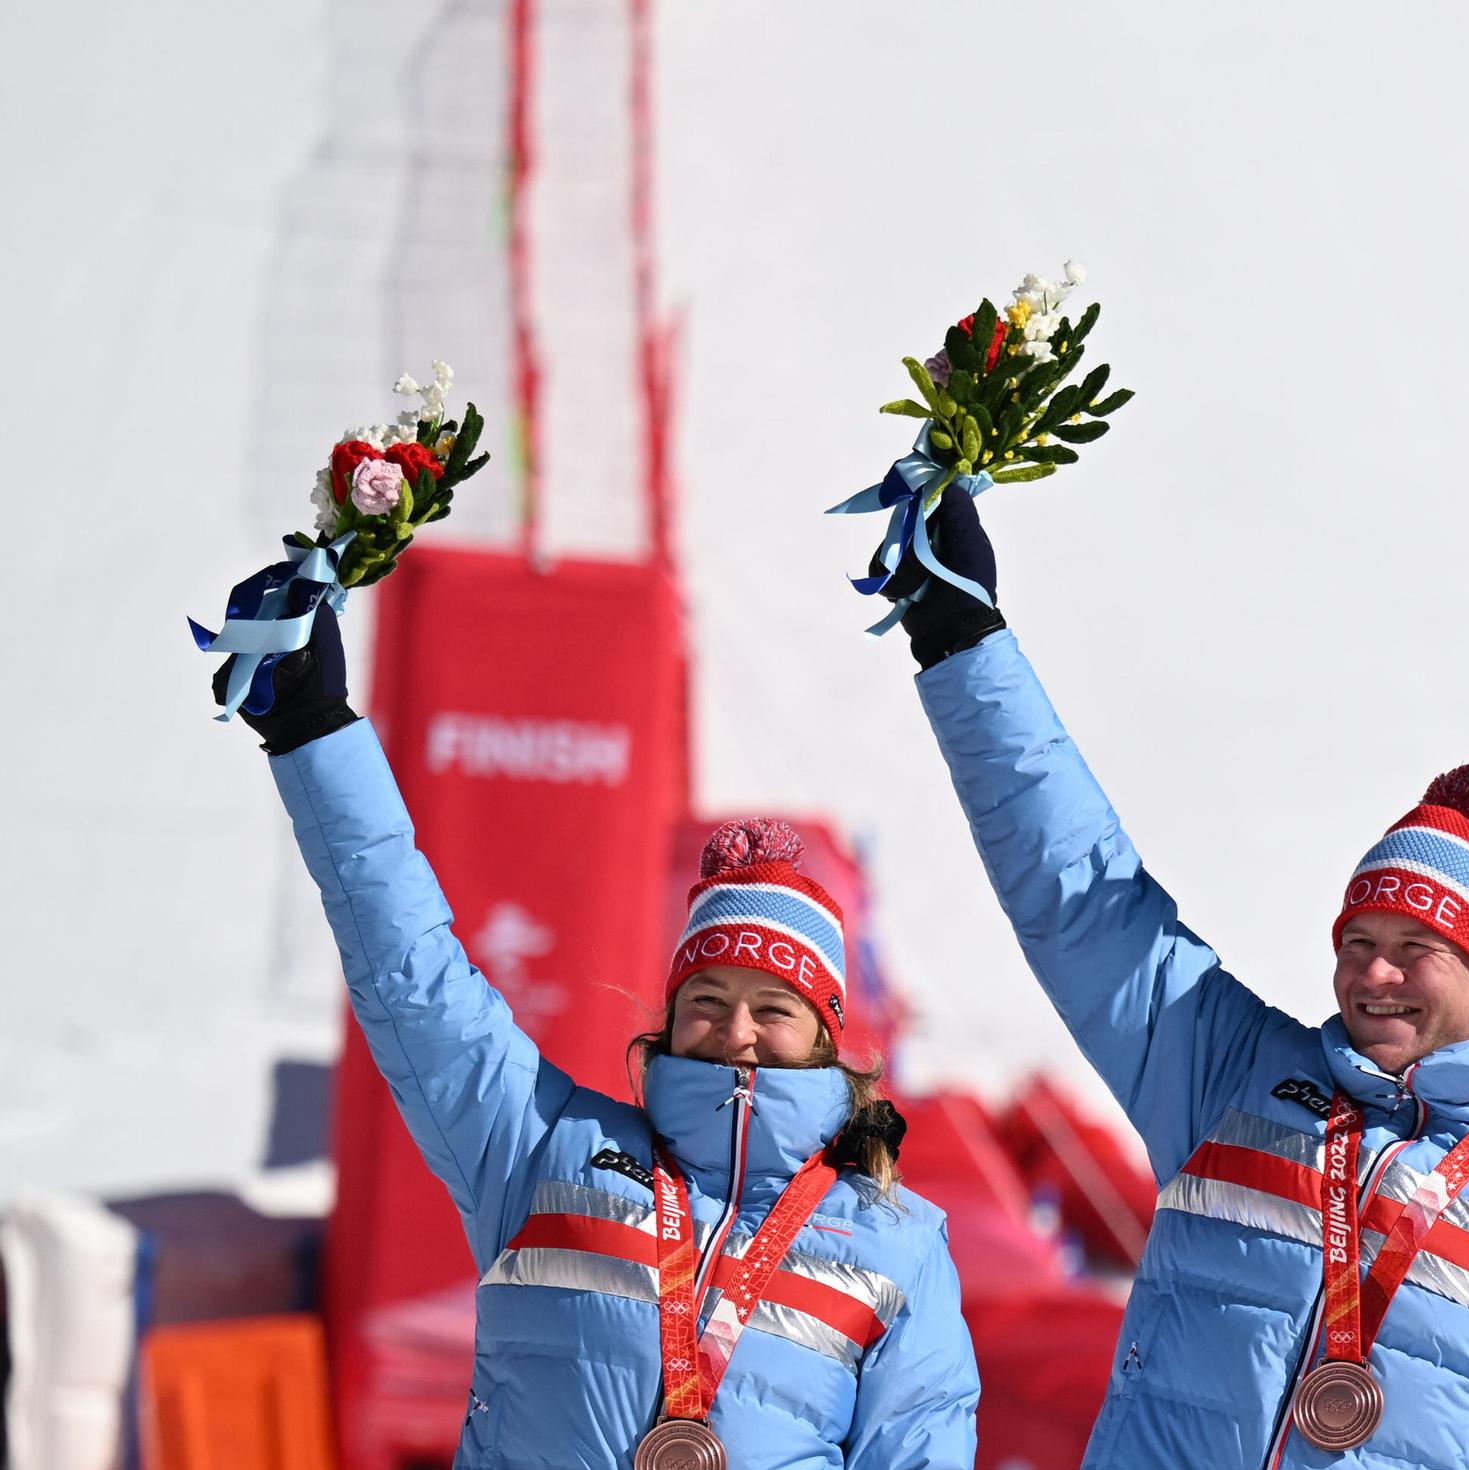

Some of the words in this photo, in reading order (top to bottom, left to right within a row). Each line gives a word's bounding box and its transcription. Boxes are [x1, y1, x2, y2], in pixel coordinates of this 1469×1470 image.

[427, 710, 631, 786] FINISH
[1345, 876, 1462, 929] ORGE
[678, 931, 817, 990] NORGE
[1330, 1129, 1351, 1182] 2022
[661, 1181, 686, 1241] BEIJING
[1329, 1187, 1352, 1264] BEIJING
